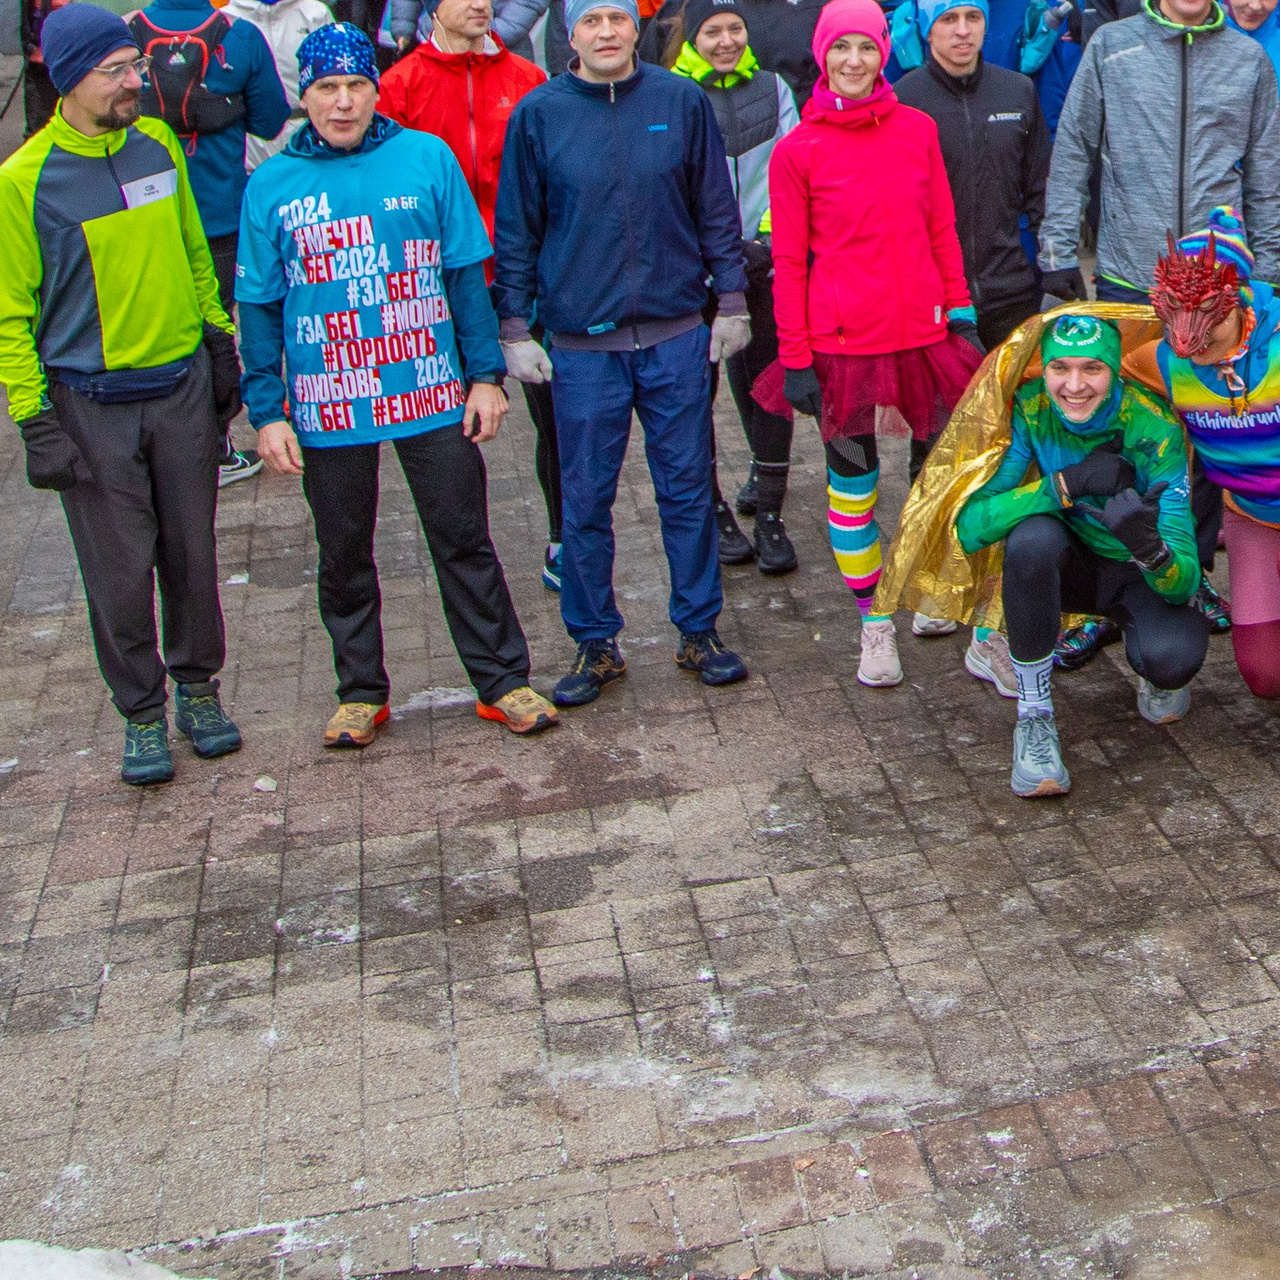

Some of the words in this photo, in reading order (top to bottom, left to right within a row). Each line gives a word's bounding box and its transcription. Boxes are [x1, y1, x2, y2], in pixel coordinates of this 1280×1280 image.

[278, 191, 332, 232] 2024
[293, 214, 375, 258] #МЕЧТА
[403, 238, 442, 270] #ЦЕЛ
[296, 308, 363, 346] #ЗАБЕГ
[380, 293, 452, 335] #МОМЕН
[323, 326, 438, 373] #ГОРДОСТЬ
[294, 367, 383, 405] #ЛЮБОВЬ
